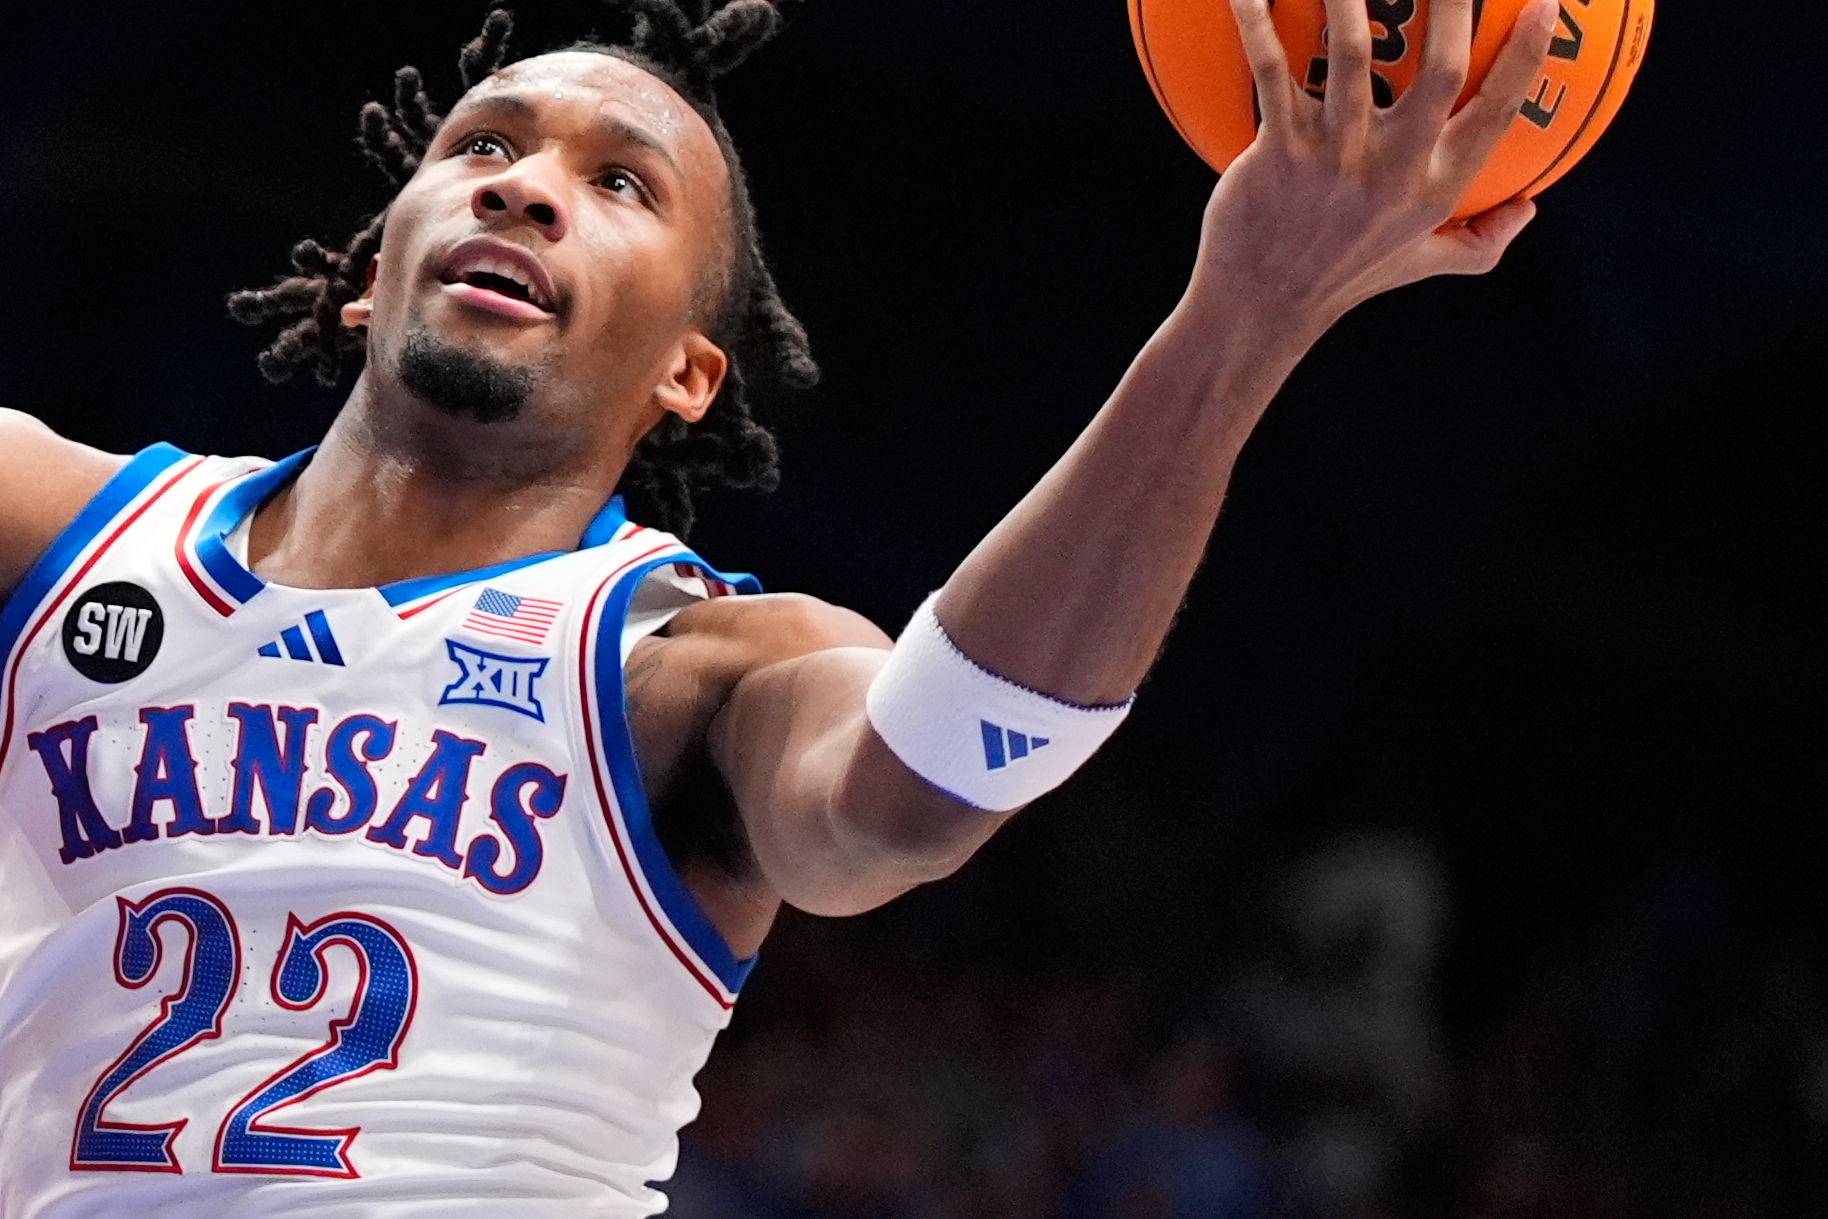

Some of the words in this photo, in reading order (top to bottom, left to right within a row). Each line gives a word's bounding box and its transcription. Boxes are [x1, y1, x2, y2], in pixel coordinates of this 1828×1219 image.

[73, 601, 153, 663] SW
[27, 701, 569, 896] KANSAS
[69, 886, 420, 1179] 22
